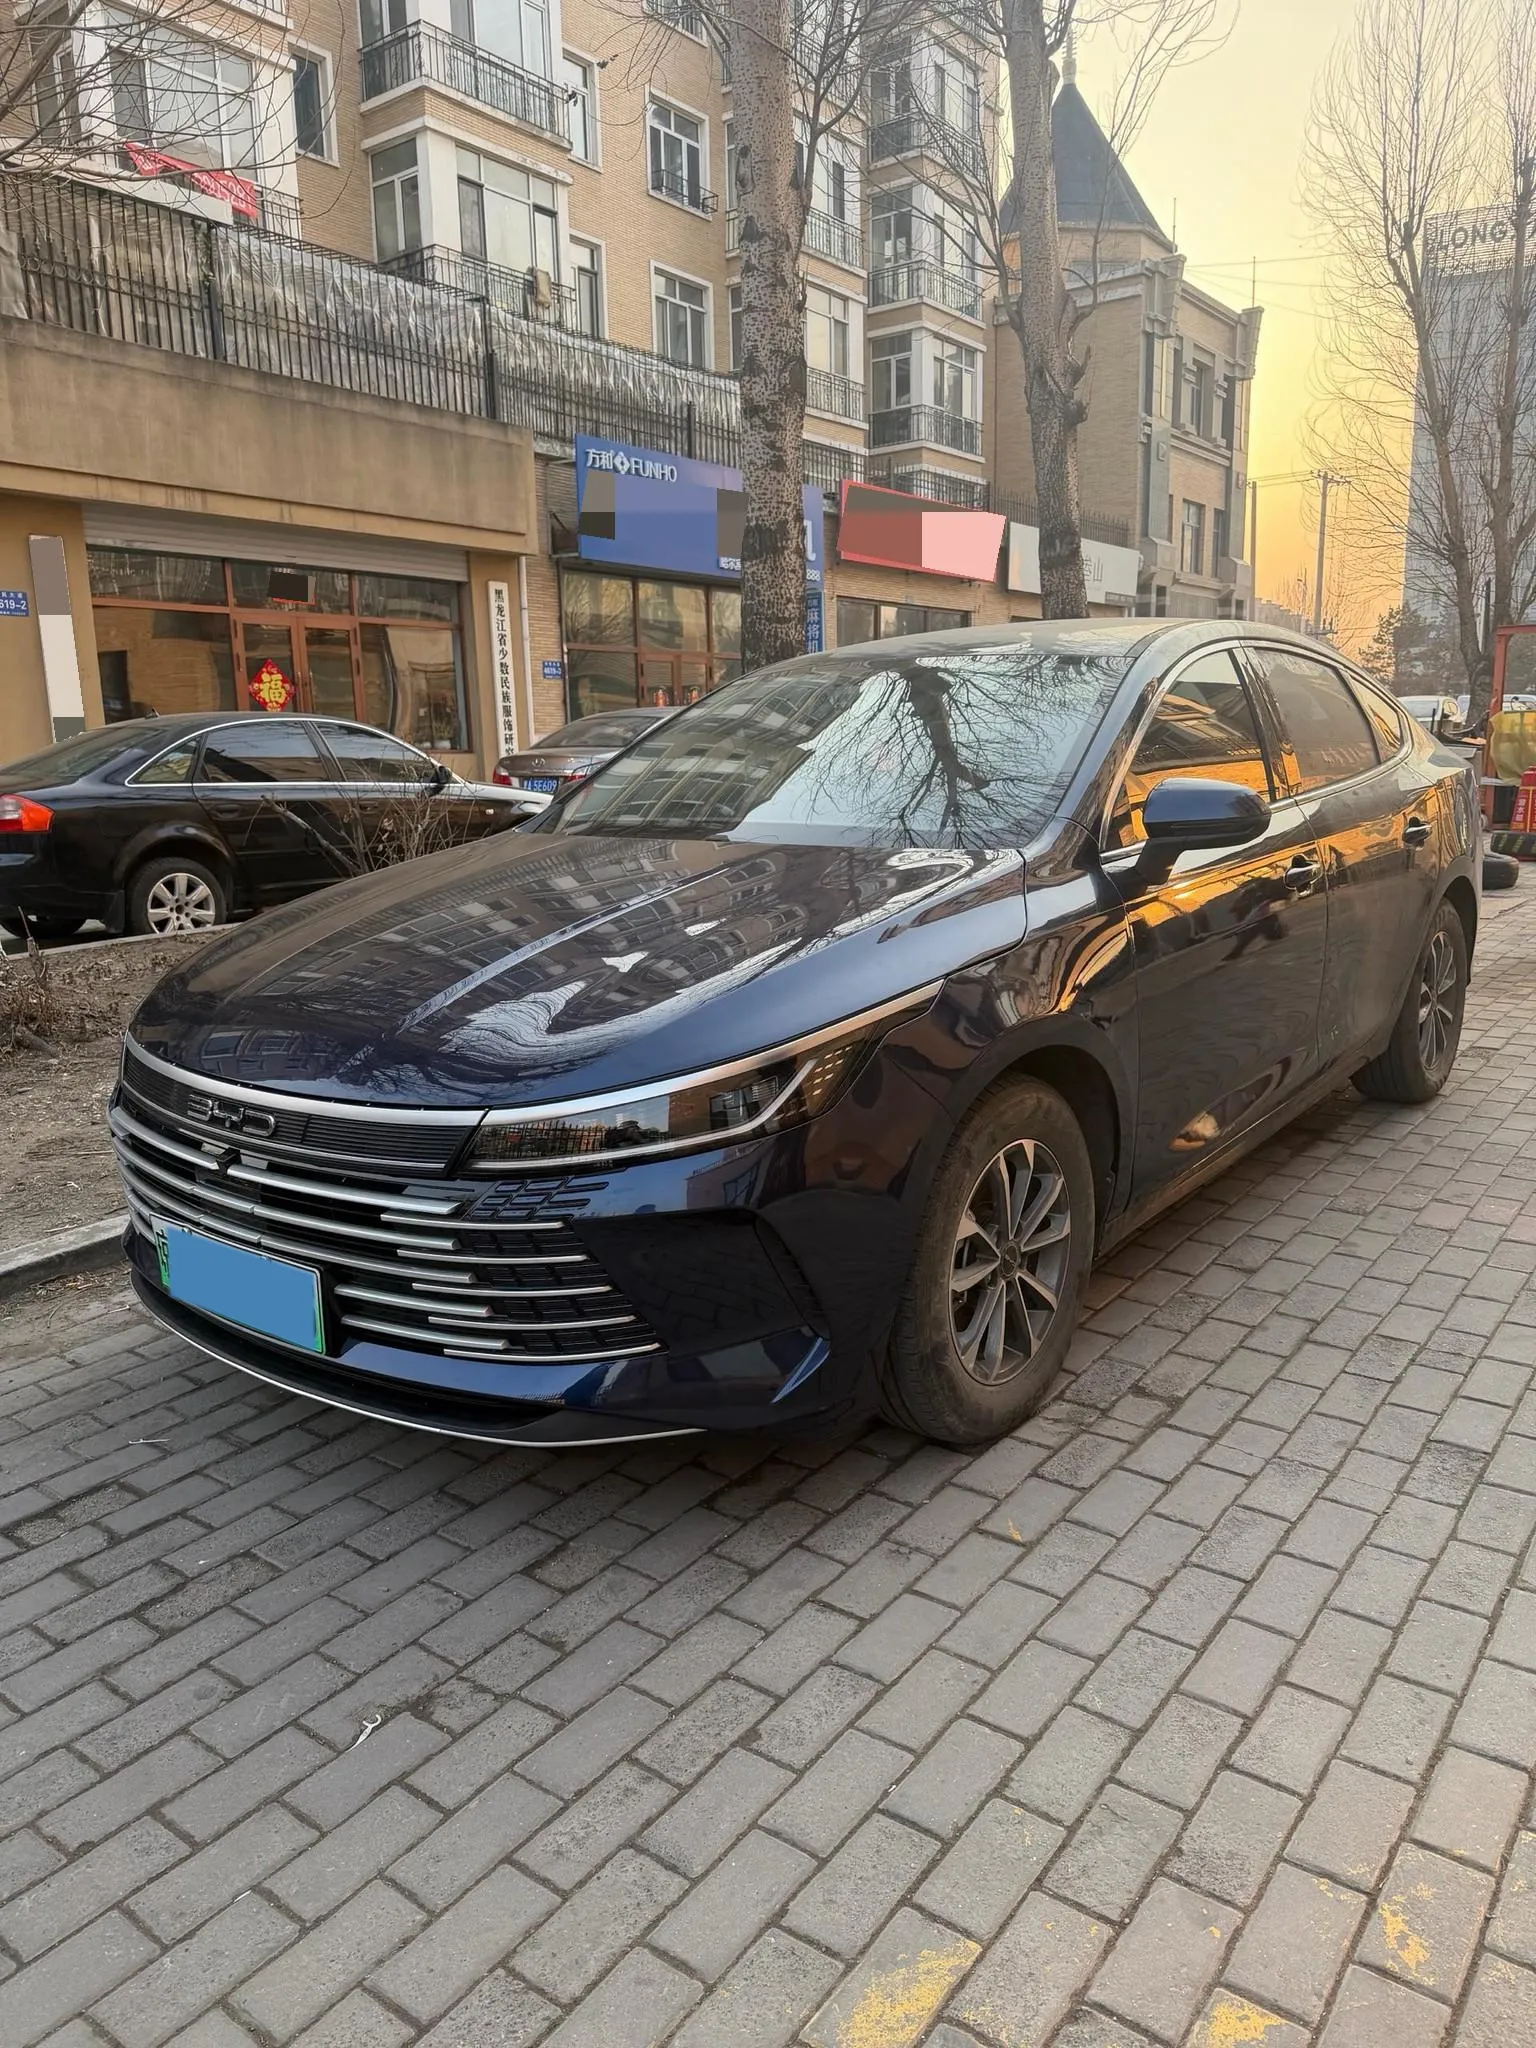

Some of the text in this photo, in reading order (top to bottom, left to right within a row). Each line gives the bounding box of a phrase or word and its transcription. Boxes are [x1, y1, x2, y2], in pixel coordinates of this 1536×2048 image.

[585, 448, 614, 469] 方和
[630, 457, 677, 482] FUNHO
[260, 672, 287, 704] 福
[187, 1094, 276, 1137] BYD
